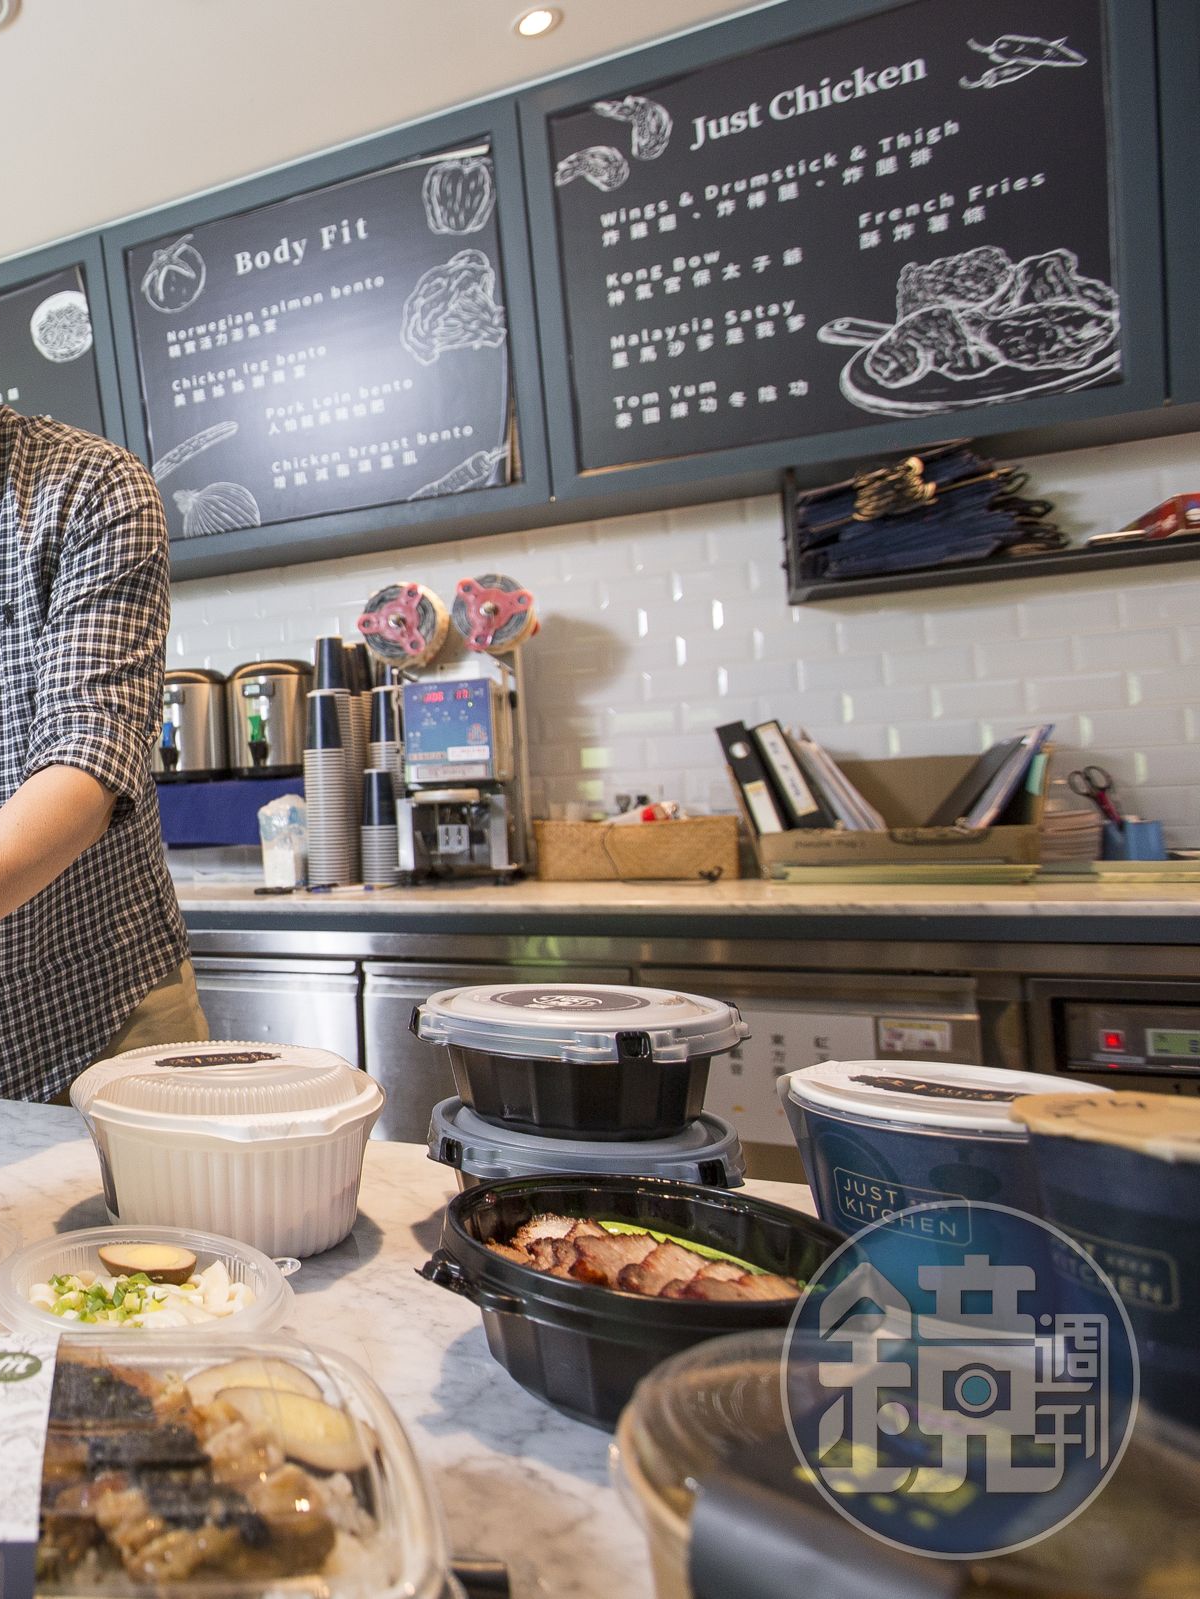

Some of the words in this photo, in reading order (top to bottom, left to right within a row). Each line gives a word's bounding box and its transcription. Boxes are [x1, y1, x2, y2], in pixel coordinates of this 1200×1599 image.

[690, 101, 764, 150] Just
[769, 58, 928, 121] Chicken
[600, 200, 669, 228] Wings
[679, 191, 694, 207] &
[705, 152, 838, 200] Drumstick
[850, 145, 867, 162] &
[878, 120, 959, 153] Thigh
[858, 193, 955, 229] French
[968, 173, 1046, 202] Fries
[234, 237, 307, 276] Body
[320, 217, 368, 250] Fit
[606, 264, 663, 288] Kong
[673, 250, 720, 272] Bow
[167, 311, 254, 343] Norwegian
[261, 292, 323, 318] salmon
[330, 275, 385, 299] bento
[610, 317, 714, 350] Malaysia
[725, 300, 796, 326] Satay
[171, 367, 237, 392] Chicken
[243, 359, 270, 375] leg
[276, 345, 327, 367] bento
[266, 401, 305, 420] Pork
[313, 391, 352, 410] Loin
[359, 378, 414, 399] bento
[613, 392, 659, 410] Tom
[669, 381, 717, 400] Yum
[272, 451, 341, 474] Chicken
[349, 437, 409, 459] breast
[416, 425, 473, 446] bento
[843, 1179, 897, 1204] JUST
[845, 1196, 956, 1237] KITCHEN
